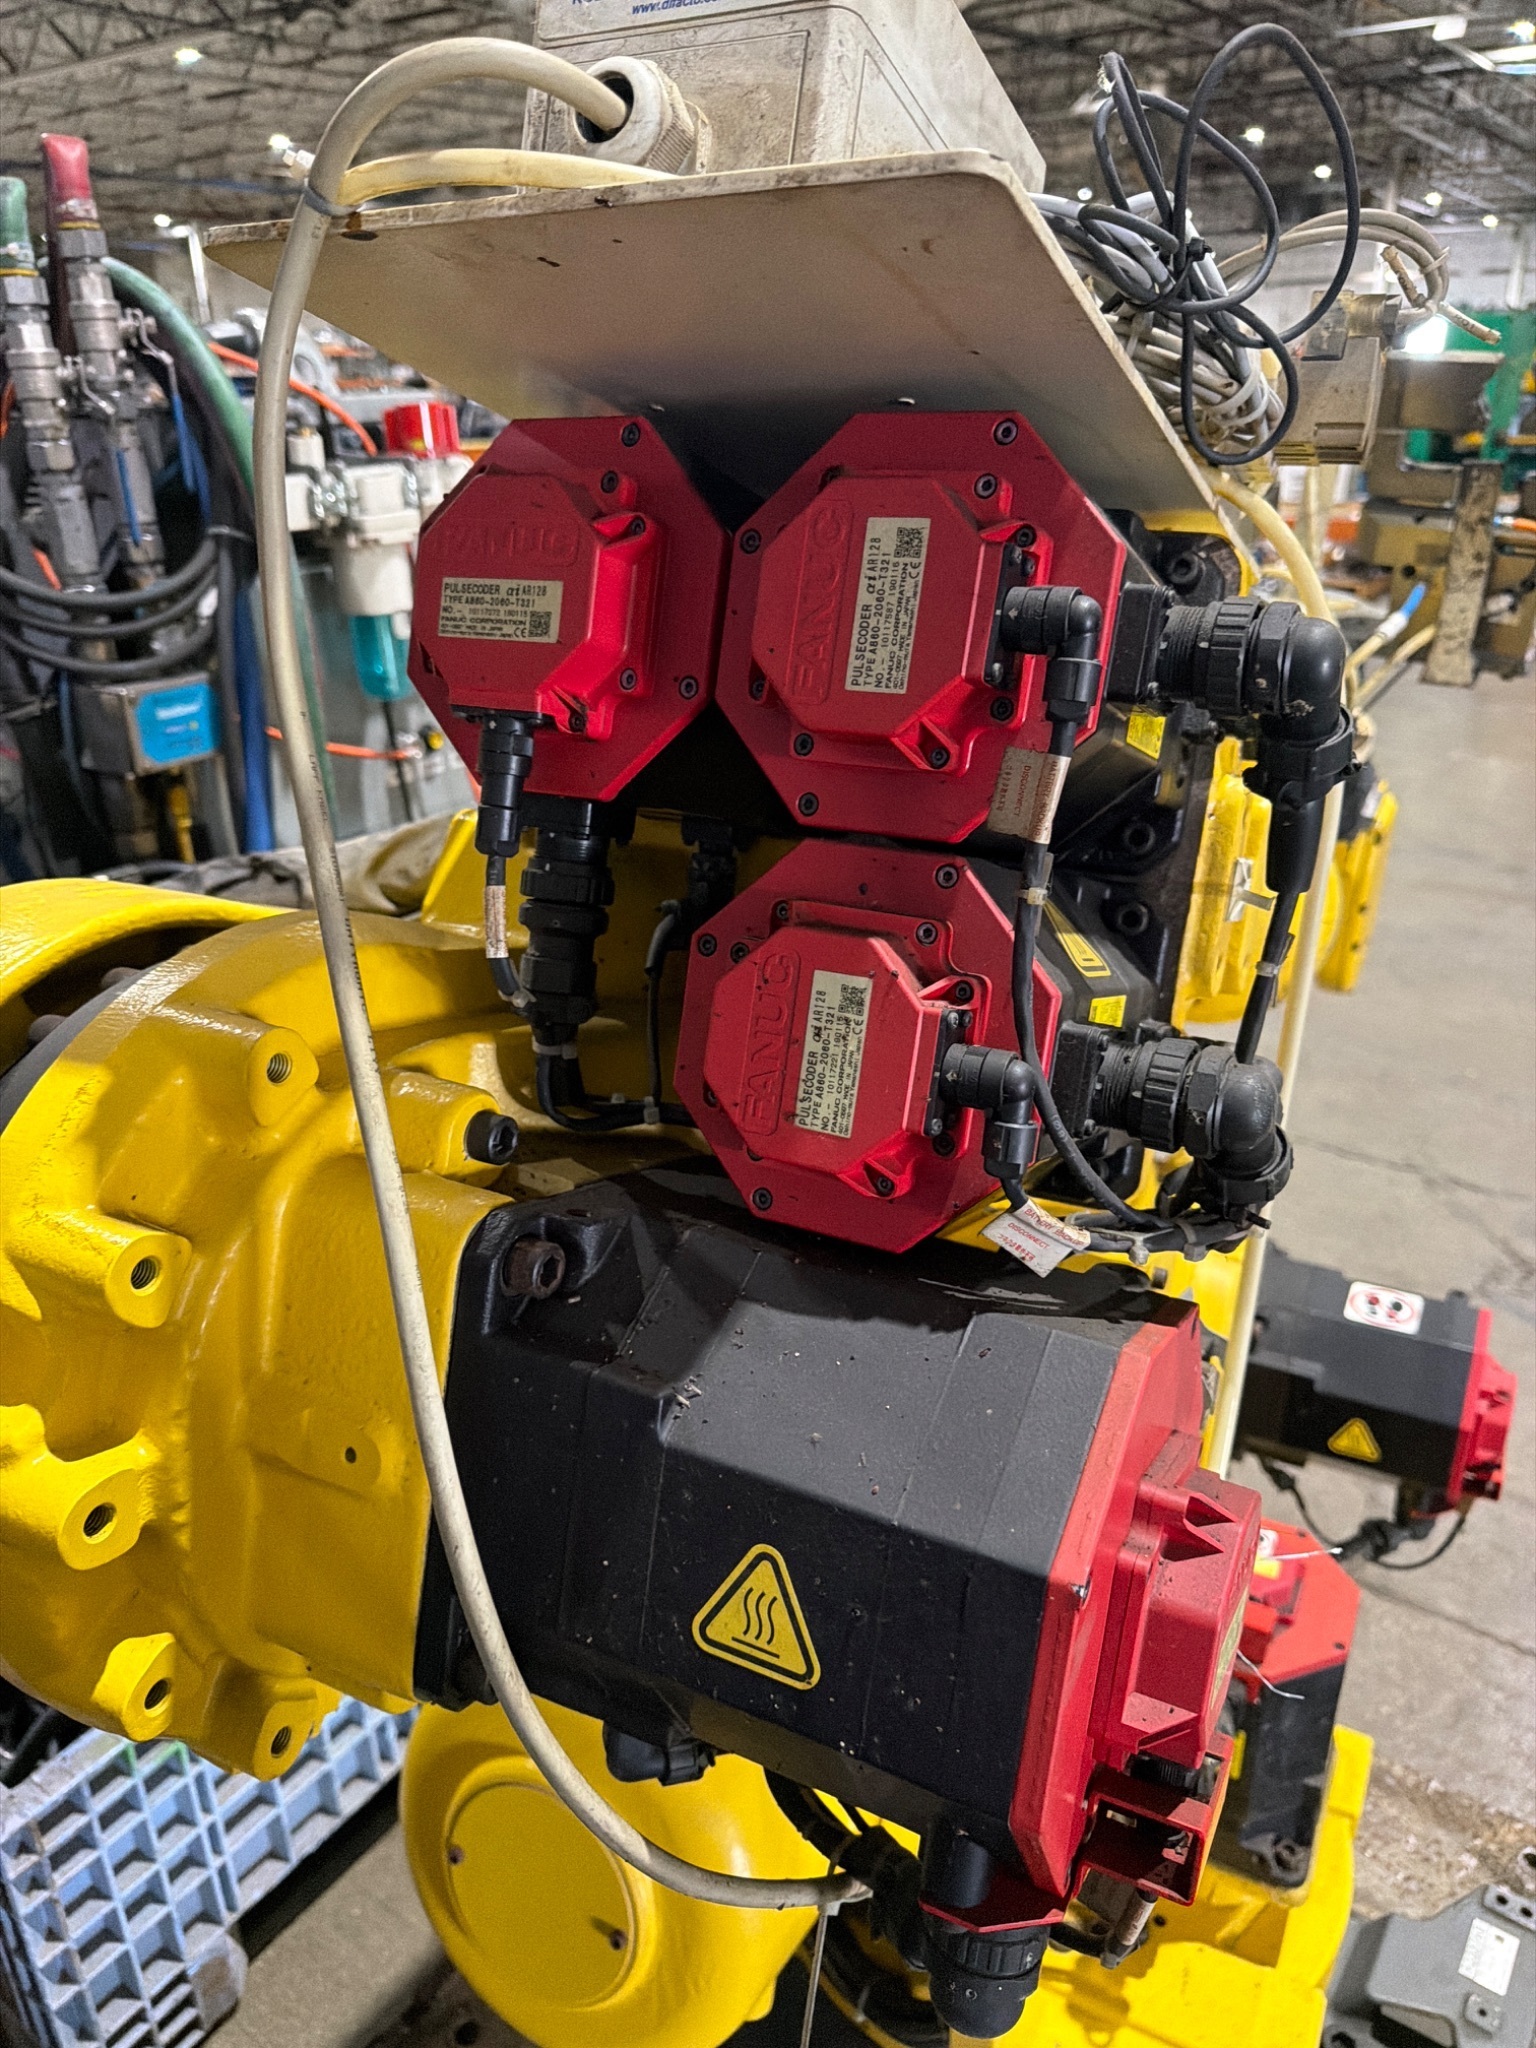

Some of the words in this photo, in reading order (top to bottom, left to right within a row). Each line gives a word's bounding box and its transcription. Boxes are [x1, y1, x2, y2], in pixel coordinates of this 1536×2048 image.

[444, 583, 500, 594] PULSECODER
[444, 595, 464, 604] TYPE
[469, 618, 526, 626] CORPORATION
[868, 553, 890, 654] A860-2060-T321
[881, 602, 894, 647] 10117587
[889, 562, 899, 596] 190116
[885, 651, 895, 688] FANUC
[891, 563, 908, 646] CORPORATION
[851, 604, 872, 686] PULSECODER
[864, 658, 875, 686] TYPE
[742, 953, 794, 1123] FANUC
[815, 1006, 835, 1099] A860-2060-T321
[831, 1098, 840, 1133] FANUC
[836, 1016, 852, 1094] CORPORATION
[798, 1051, 817, 1126] PULSECODER
[811, 1102, 821, 1127] TYPE
[1008, 1222, 1050, 1249] DISCONNECT
[1024, 1208, 1054, 1231] BATTERY
